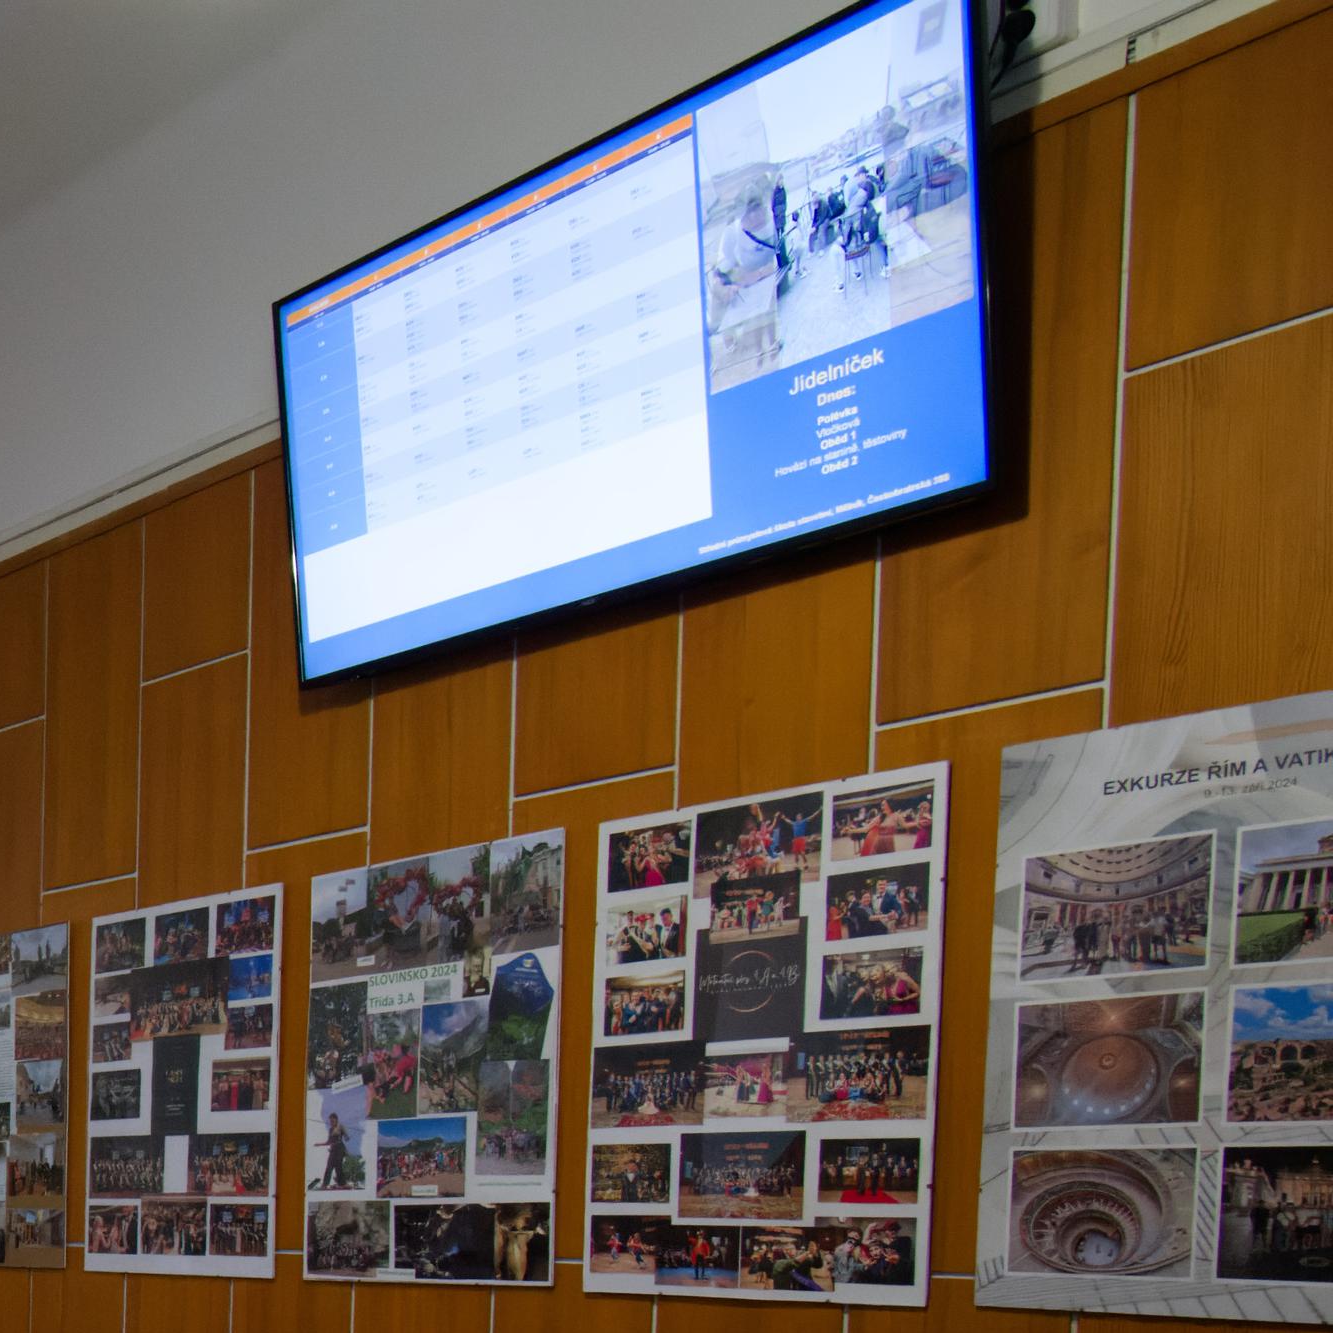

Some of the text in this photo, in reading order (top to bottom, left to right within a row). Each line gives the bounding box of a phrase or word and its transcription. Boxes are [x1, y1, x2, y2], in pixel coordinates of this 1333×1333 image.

[789, 348, 885, 395] Jídelníček
[817, 386, 856, 407] Dnes:
[850, 430, 857, 440] 1
[1103, 767, 1200, 796] EXKURZE
[1208, 760, 1246, 780] ŘÍM
[1253, 758, 1268, 773] A
[369, 964, 458, 987] SLOVINSKO 2024
[369, 992, 415, 1008] Třída 3.A
